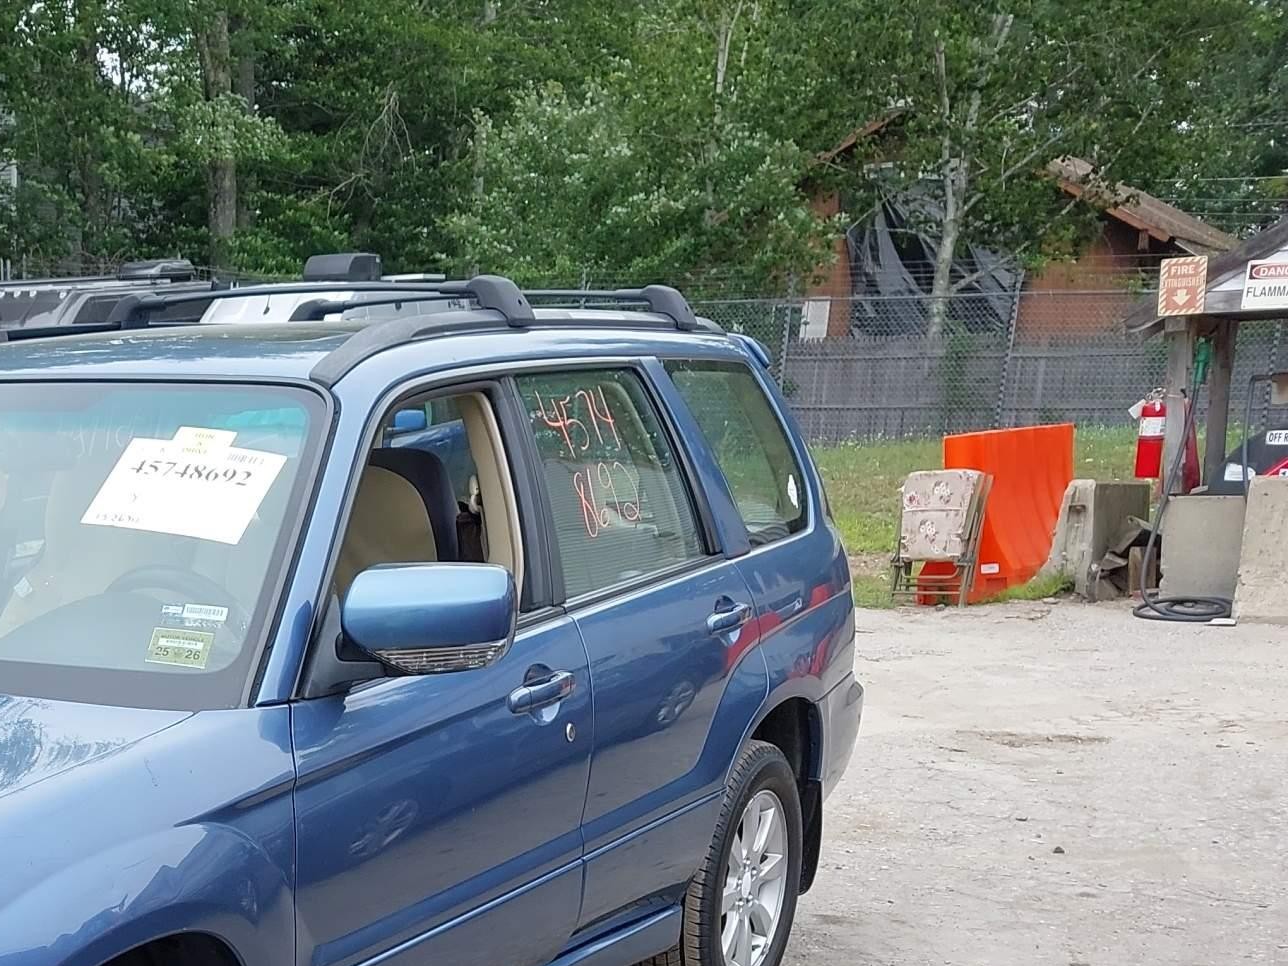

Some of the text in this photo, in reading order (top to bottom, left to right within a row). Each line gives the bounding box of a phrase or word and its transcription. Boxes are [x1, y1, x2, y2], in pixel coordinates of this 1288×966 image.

[1170, 265, 1196, 275] FIRE
[534, 384, 622, 459] 4574
[1269, 432, 1282, 443] OFF
[130, 459, 253, 487] 45748692
[573, 460, 642, 538] 8692
[154, 646, 201, 661] 25 26
